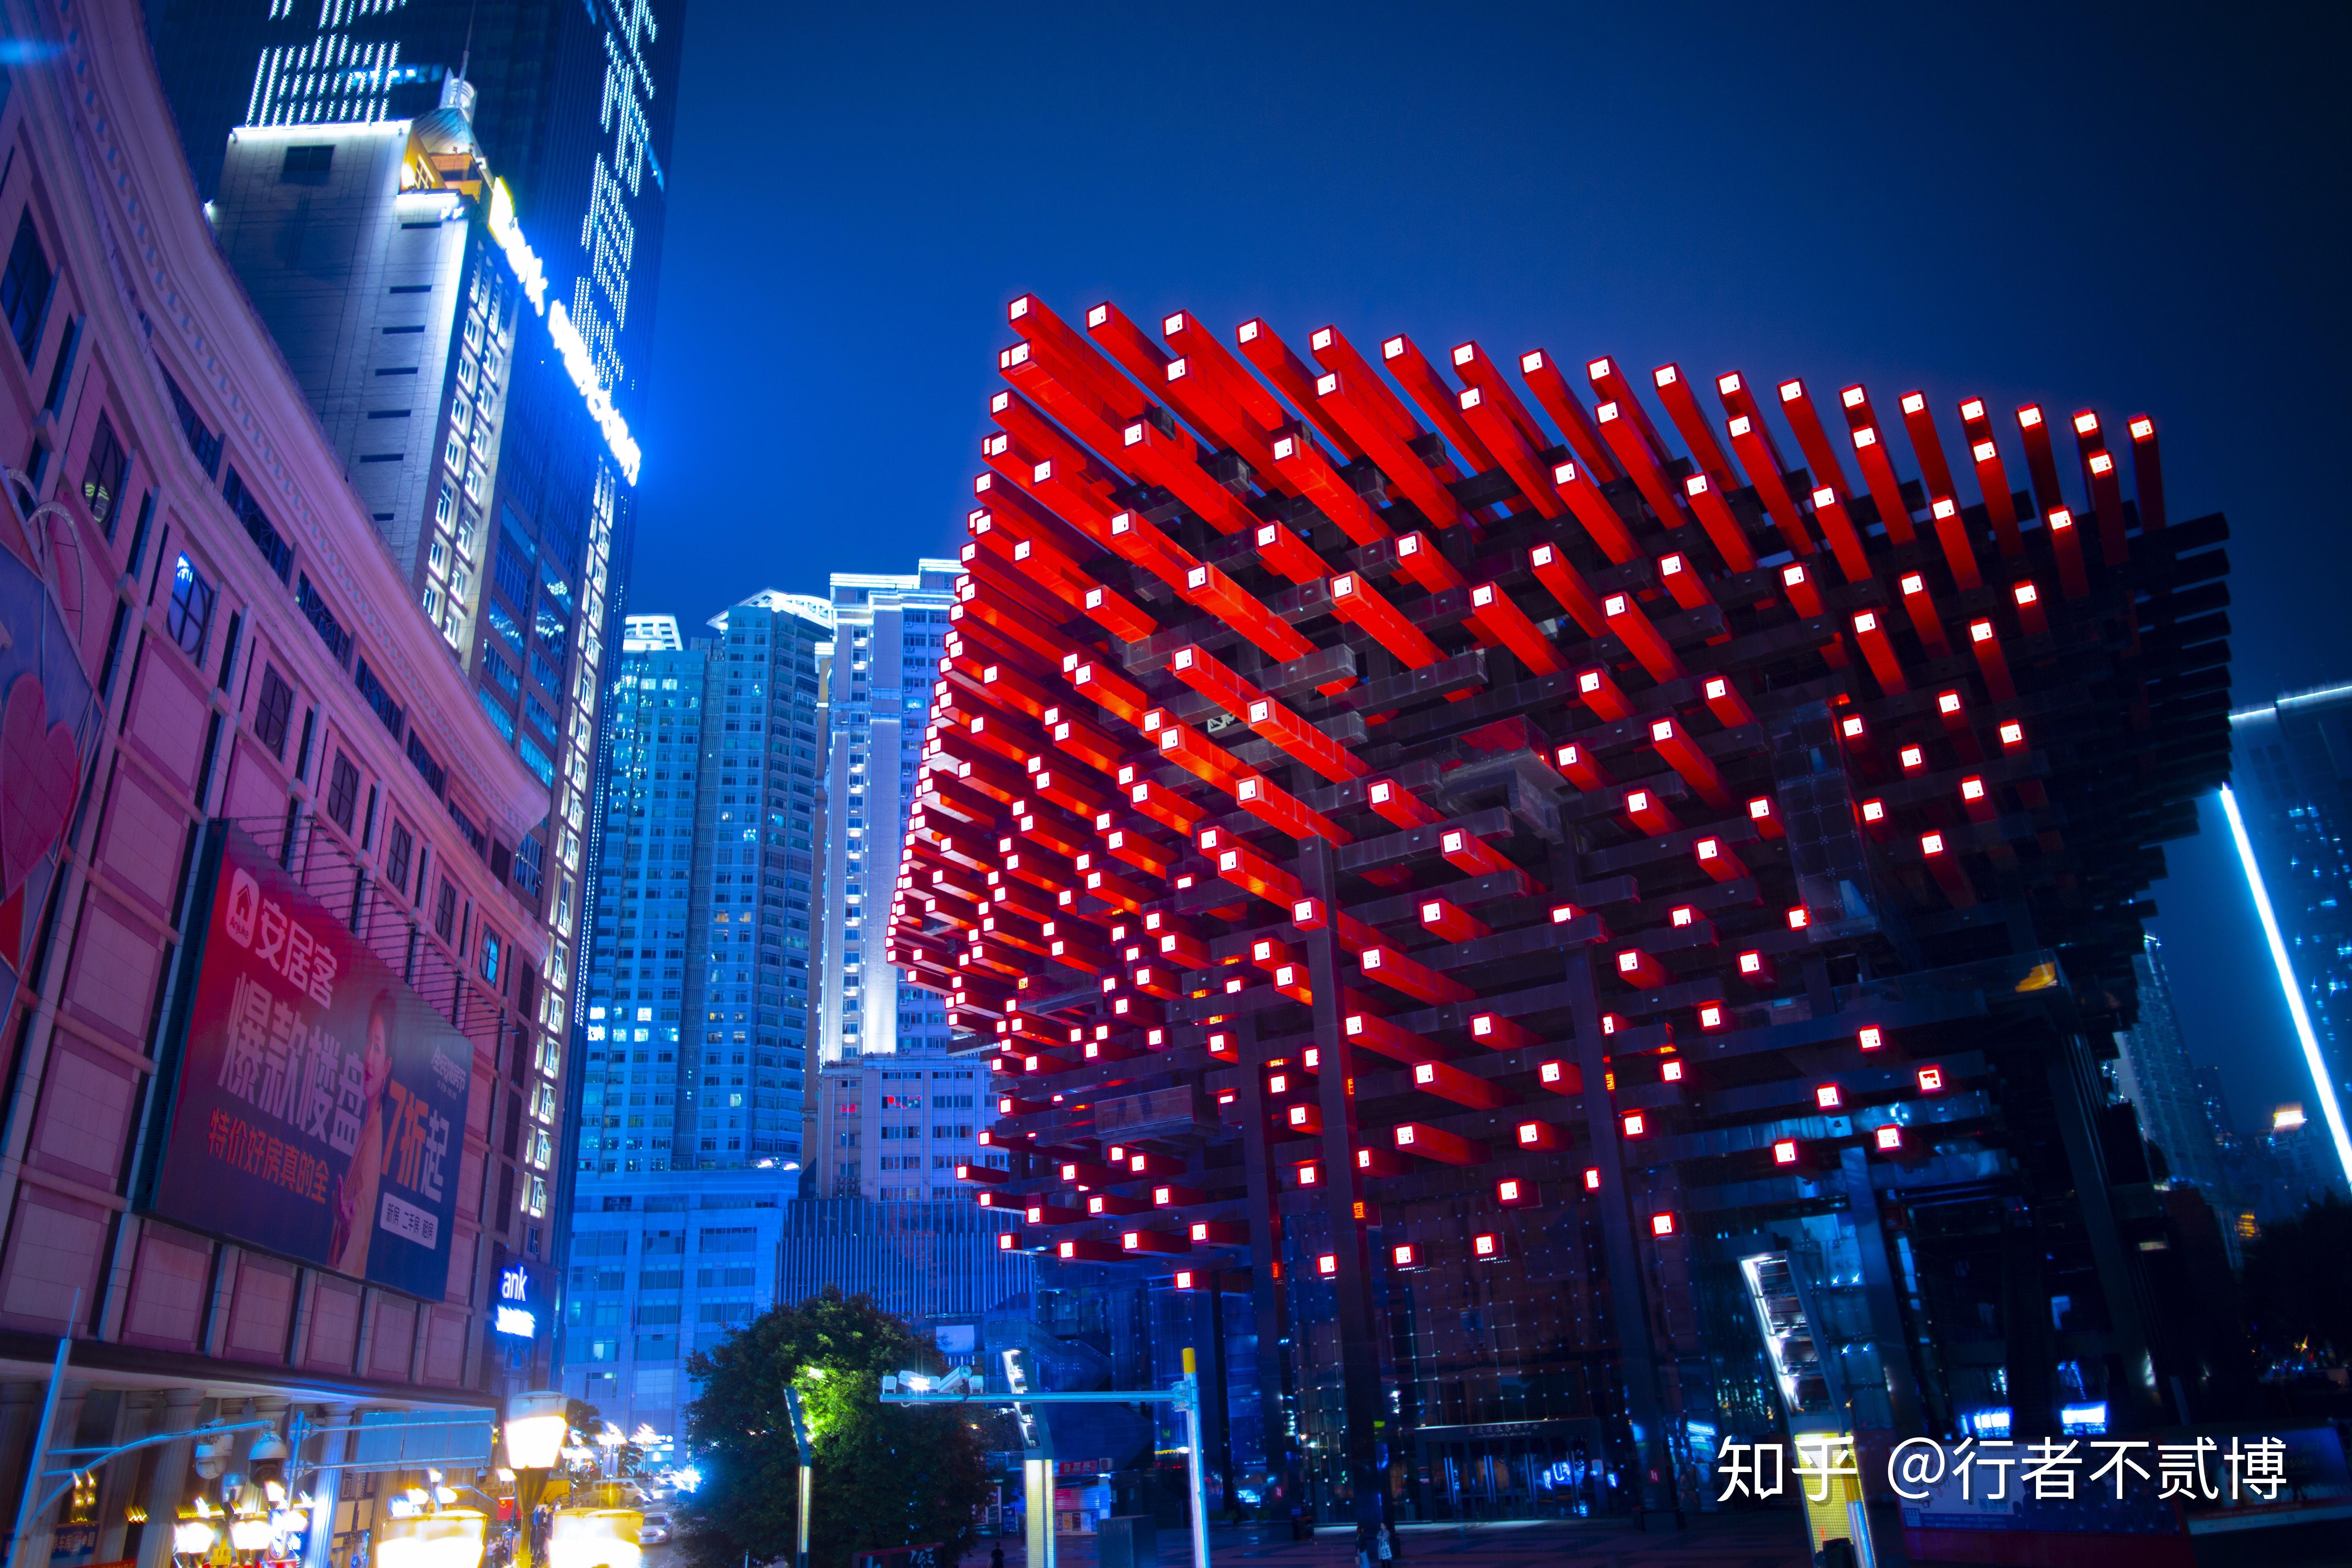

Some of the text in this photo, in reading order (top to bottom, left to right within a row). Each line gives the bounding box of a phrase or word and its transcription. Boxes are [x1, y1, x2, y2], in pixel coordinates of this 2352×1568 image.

[229, 916, 249, 939] Anjuke
[255, 898, 337, 1010] 安居客
[217, 971, 450, 1203] 爆款楼盘 7折起
[207, 1107, 329, 1204] 特价好房真的全
[386, 1203, 434, 1241] 新房 二手房 租房
[1064, 1462, 1091, 1472] 售票处
